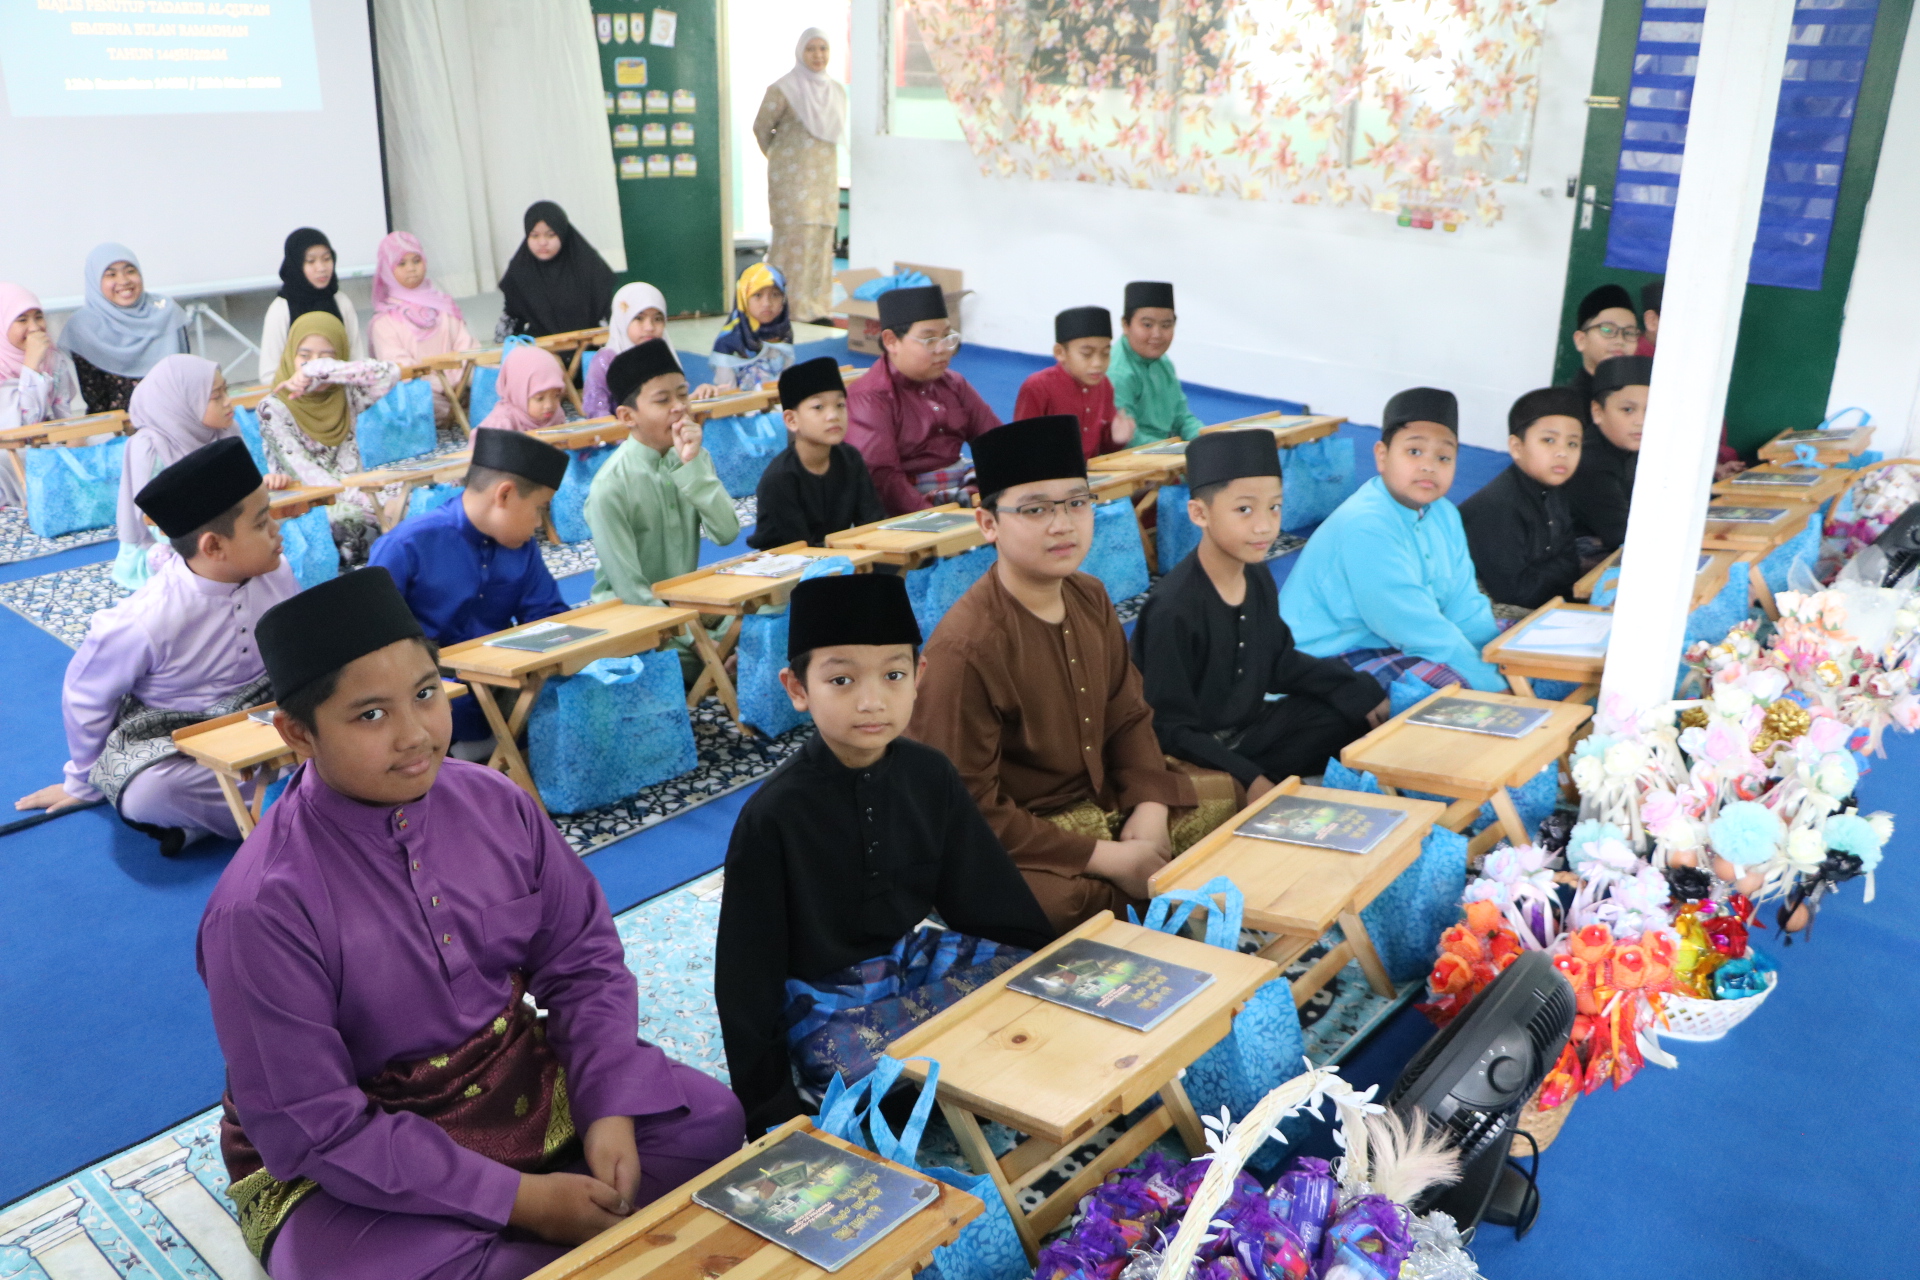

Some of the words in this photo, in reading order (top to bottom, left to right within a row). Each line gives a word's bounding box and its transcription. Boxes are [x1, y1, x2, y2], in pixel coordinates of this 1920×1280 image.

[37, 0, 84, 13] MAJLIS
[86, 0, 146, 13] PENUTUP
[147, 1, 205, 14] TADARUS
[71, 21, 132, 35] SEMPENA
[134, 22, 177, 36] BULAN
[178, 23, 249, 37] RAMADHAN
[106, 47, 154, 60] TAHUN
[1500, 1045, 1507, 1053] 3
